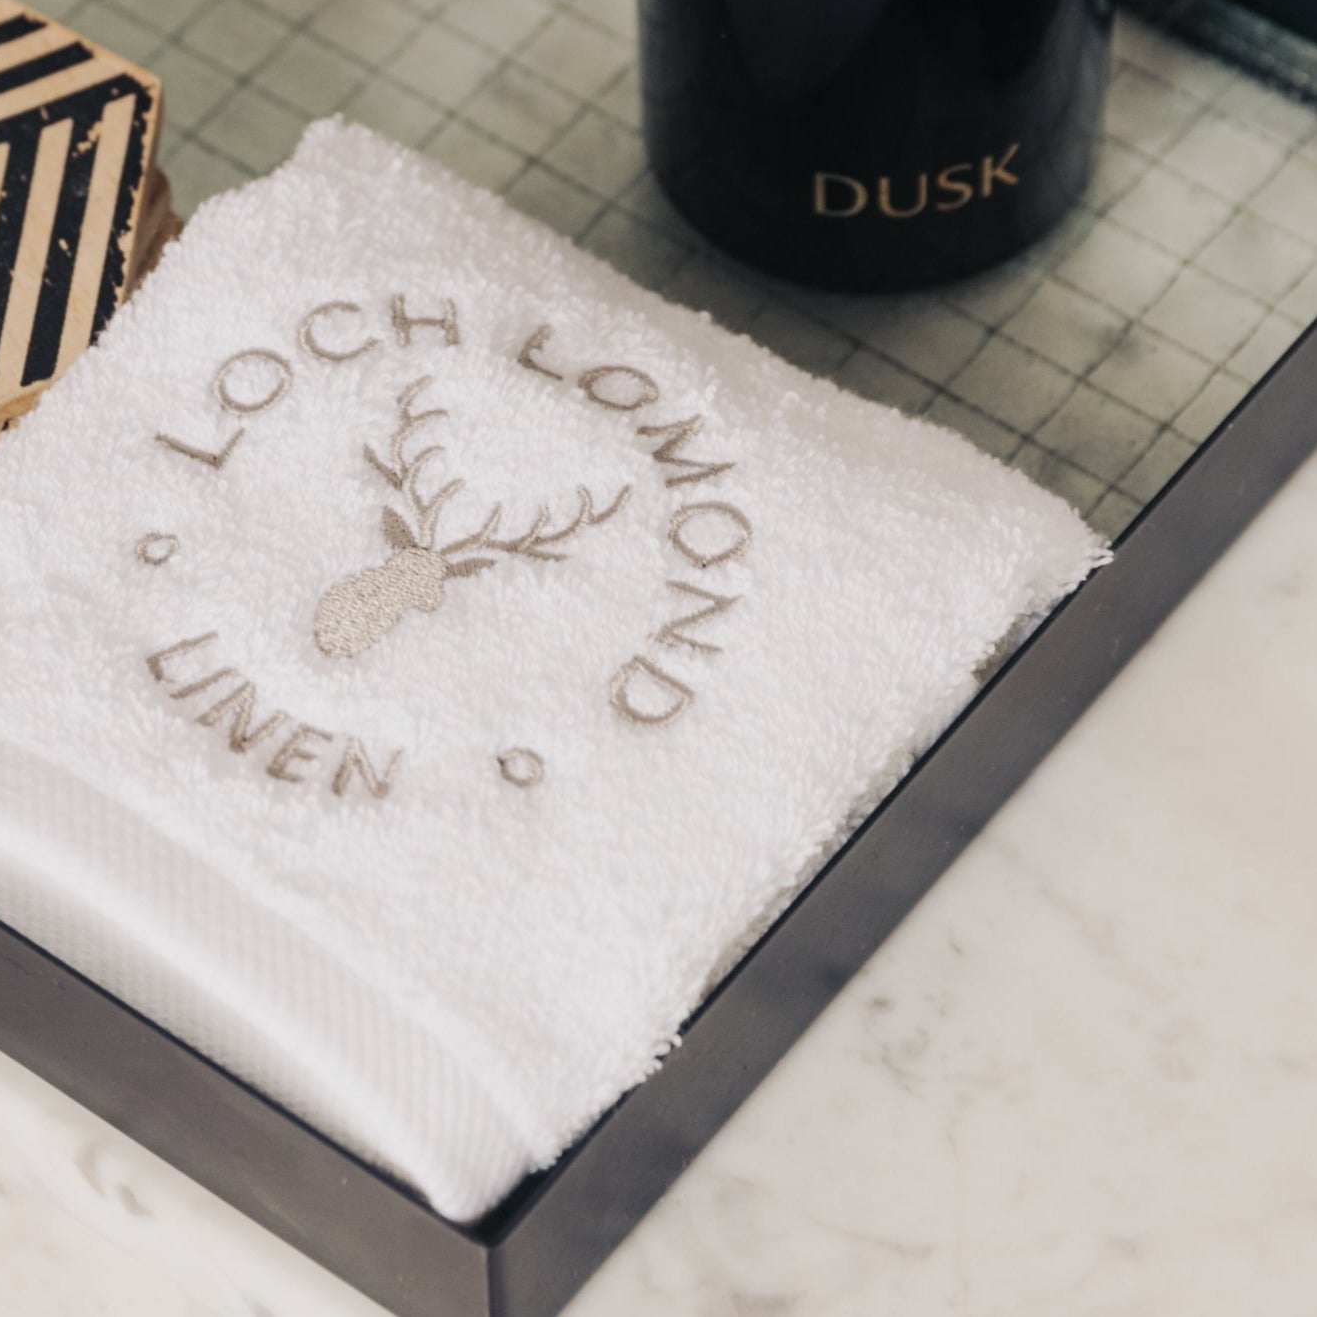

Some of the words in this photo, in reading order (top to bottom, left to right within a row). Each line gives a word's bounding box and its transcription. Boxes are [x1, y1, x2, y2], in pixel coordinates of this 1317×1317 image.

[813, 143, 1020, 218] DUSK
[154, 292, 462, 470] LOCH
[516, 323, 755, 725] LOMOND
[145, 630, 405, 798] LINEN
